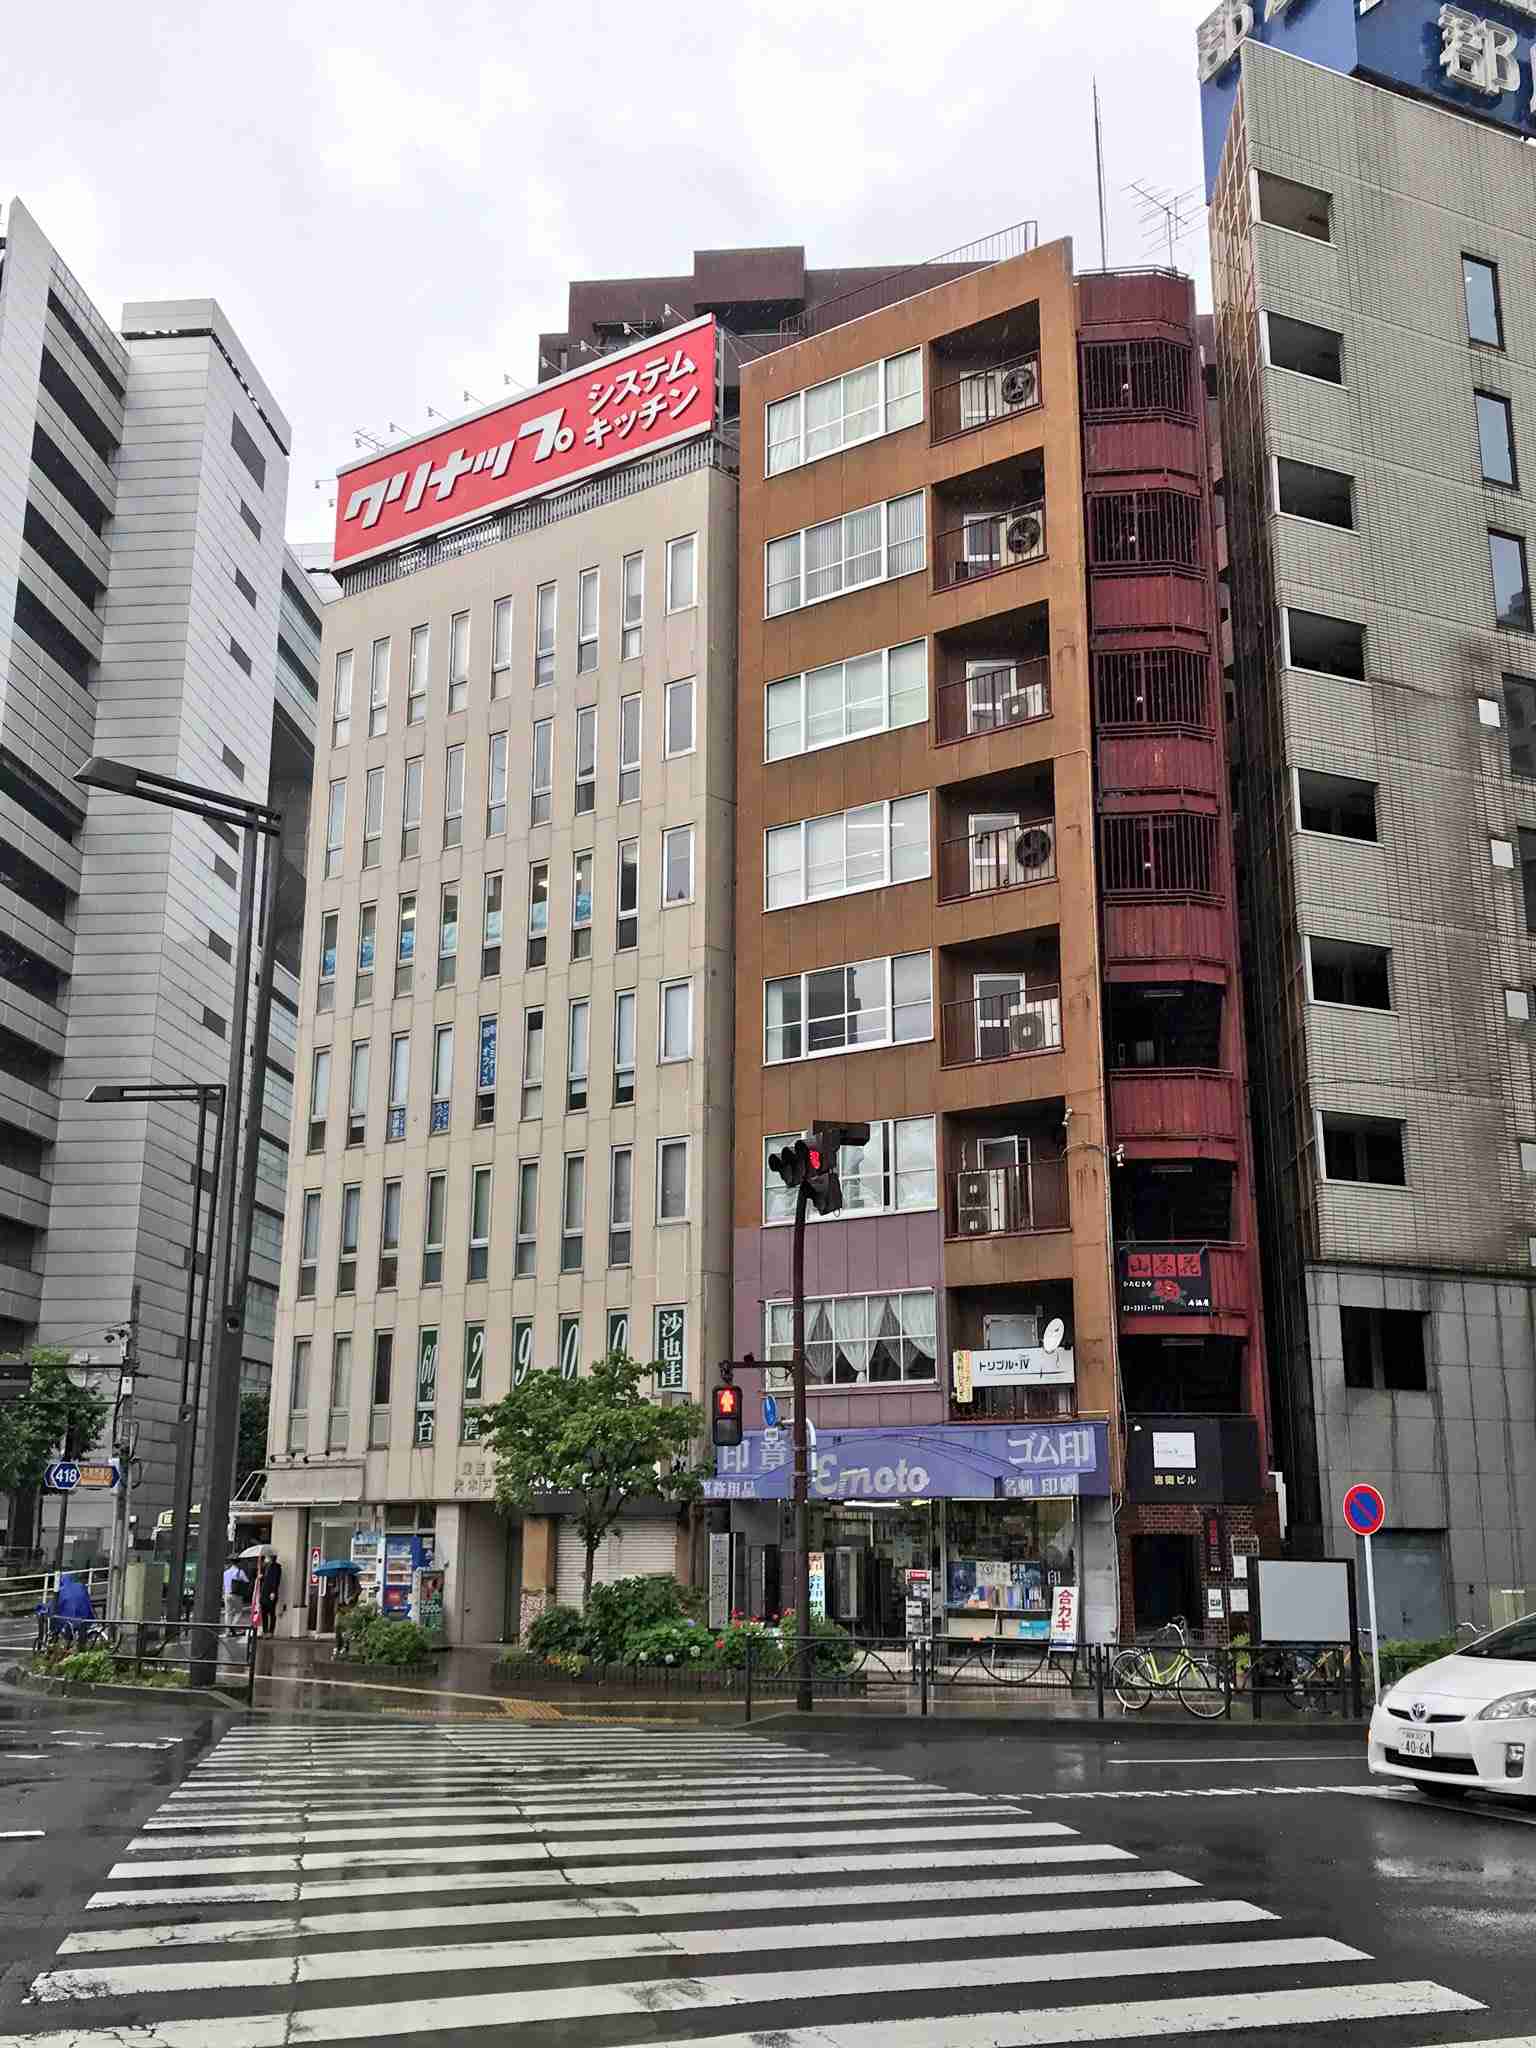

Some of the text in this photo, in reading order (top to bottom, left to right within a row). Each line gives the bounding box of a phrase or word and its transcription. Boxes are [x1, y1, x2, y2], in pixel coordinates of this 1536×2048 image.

[1438, 3, 1521, 96] 都
[586, 350, 698, 416] システム
[583, 384, 700, 450] キッチン
[343, 406, 576, 529] クリナップ
[661, 1312, 682, 1387] 沙也佳
[55, 1468, 77, 1483] 418
[814, 1454, 931, 1495] Emoto
[1007, 1427, 1091, 1468] ゴム印
[1055, 1589, 1074, 1632] 合カギ
